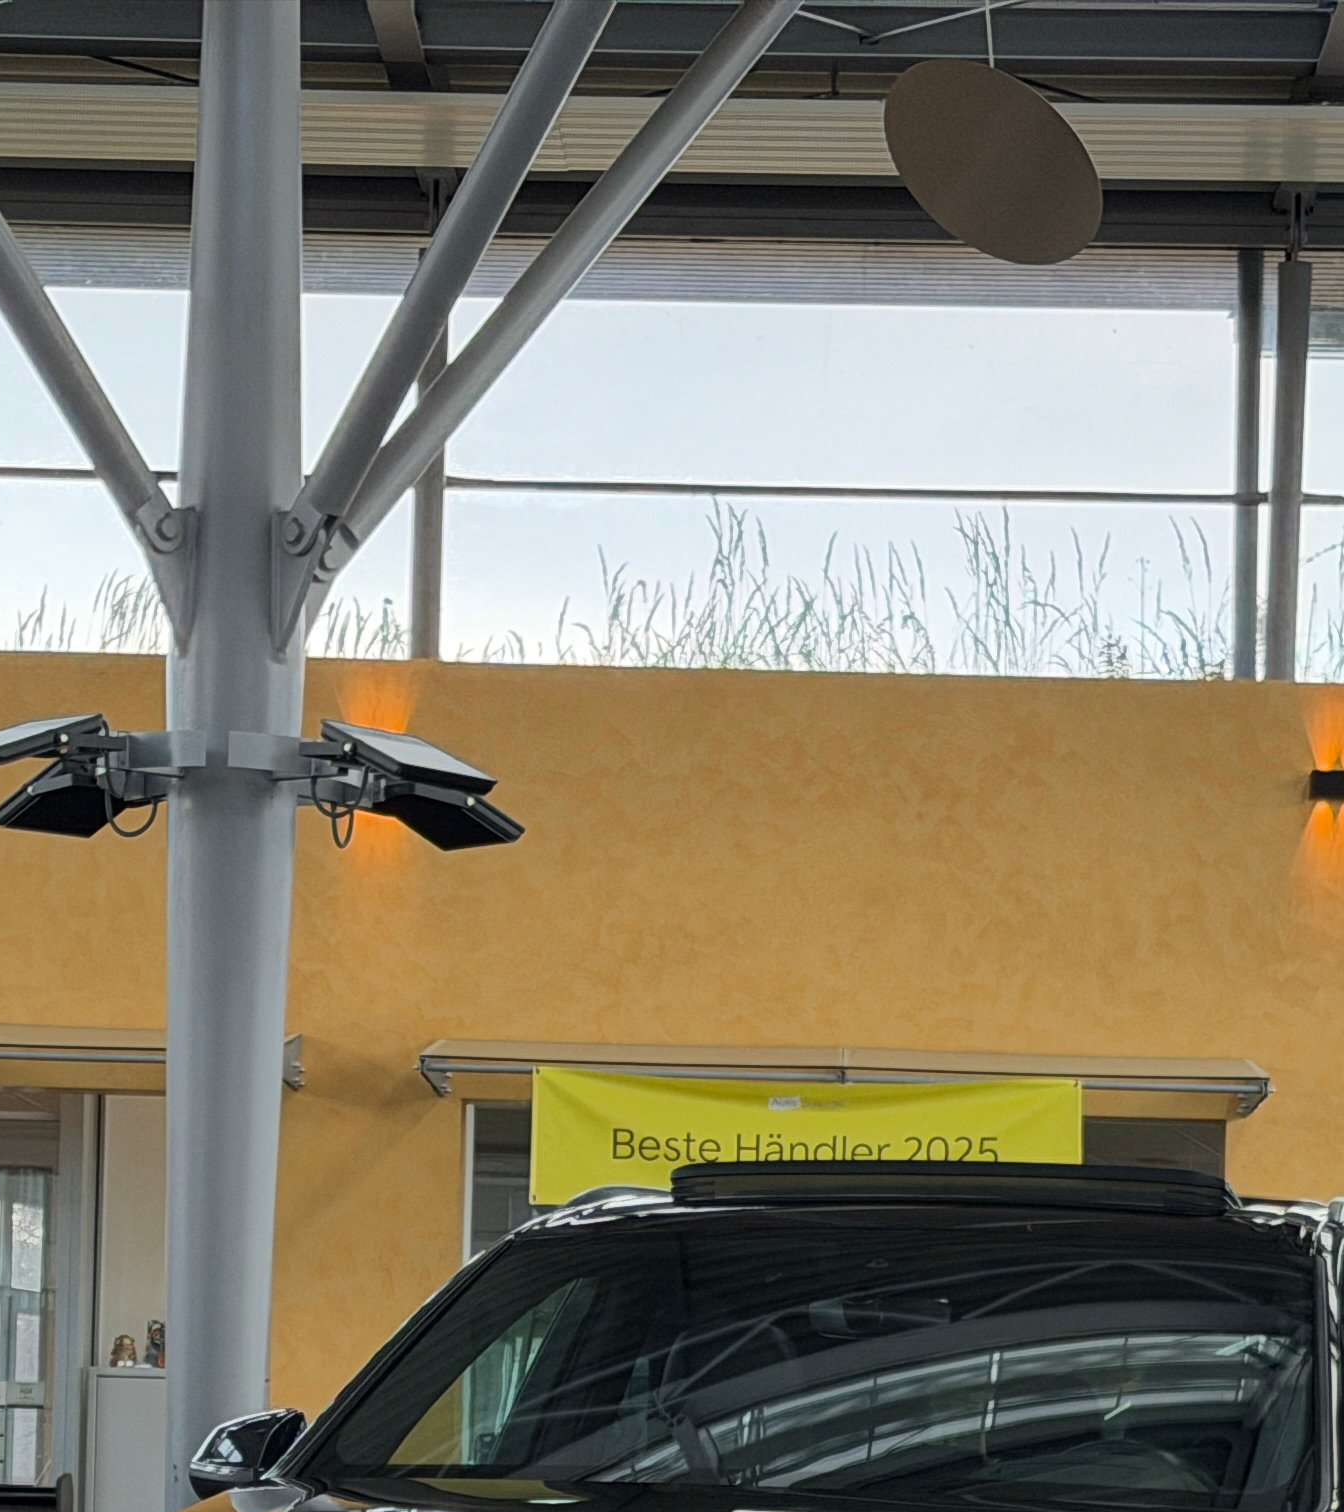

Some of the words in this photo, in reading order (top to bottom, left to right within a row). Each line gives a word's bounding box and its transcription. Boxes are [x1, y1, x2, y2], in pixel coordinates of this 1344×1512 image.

[611, 1128, 722, 1162] Beste
[736, 1132, 891, 1162] Händler
[903, 1136, 1000, 1163] 2025
